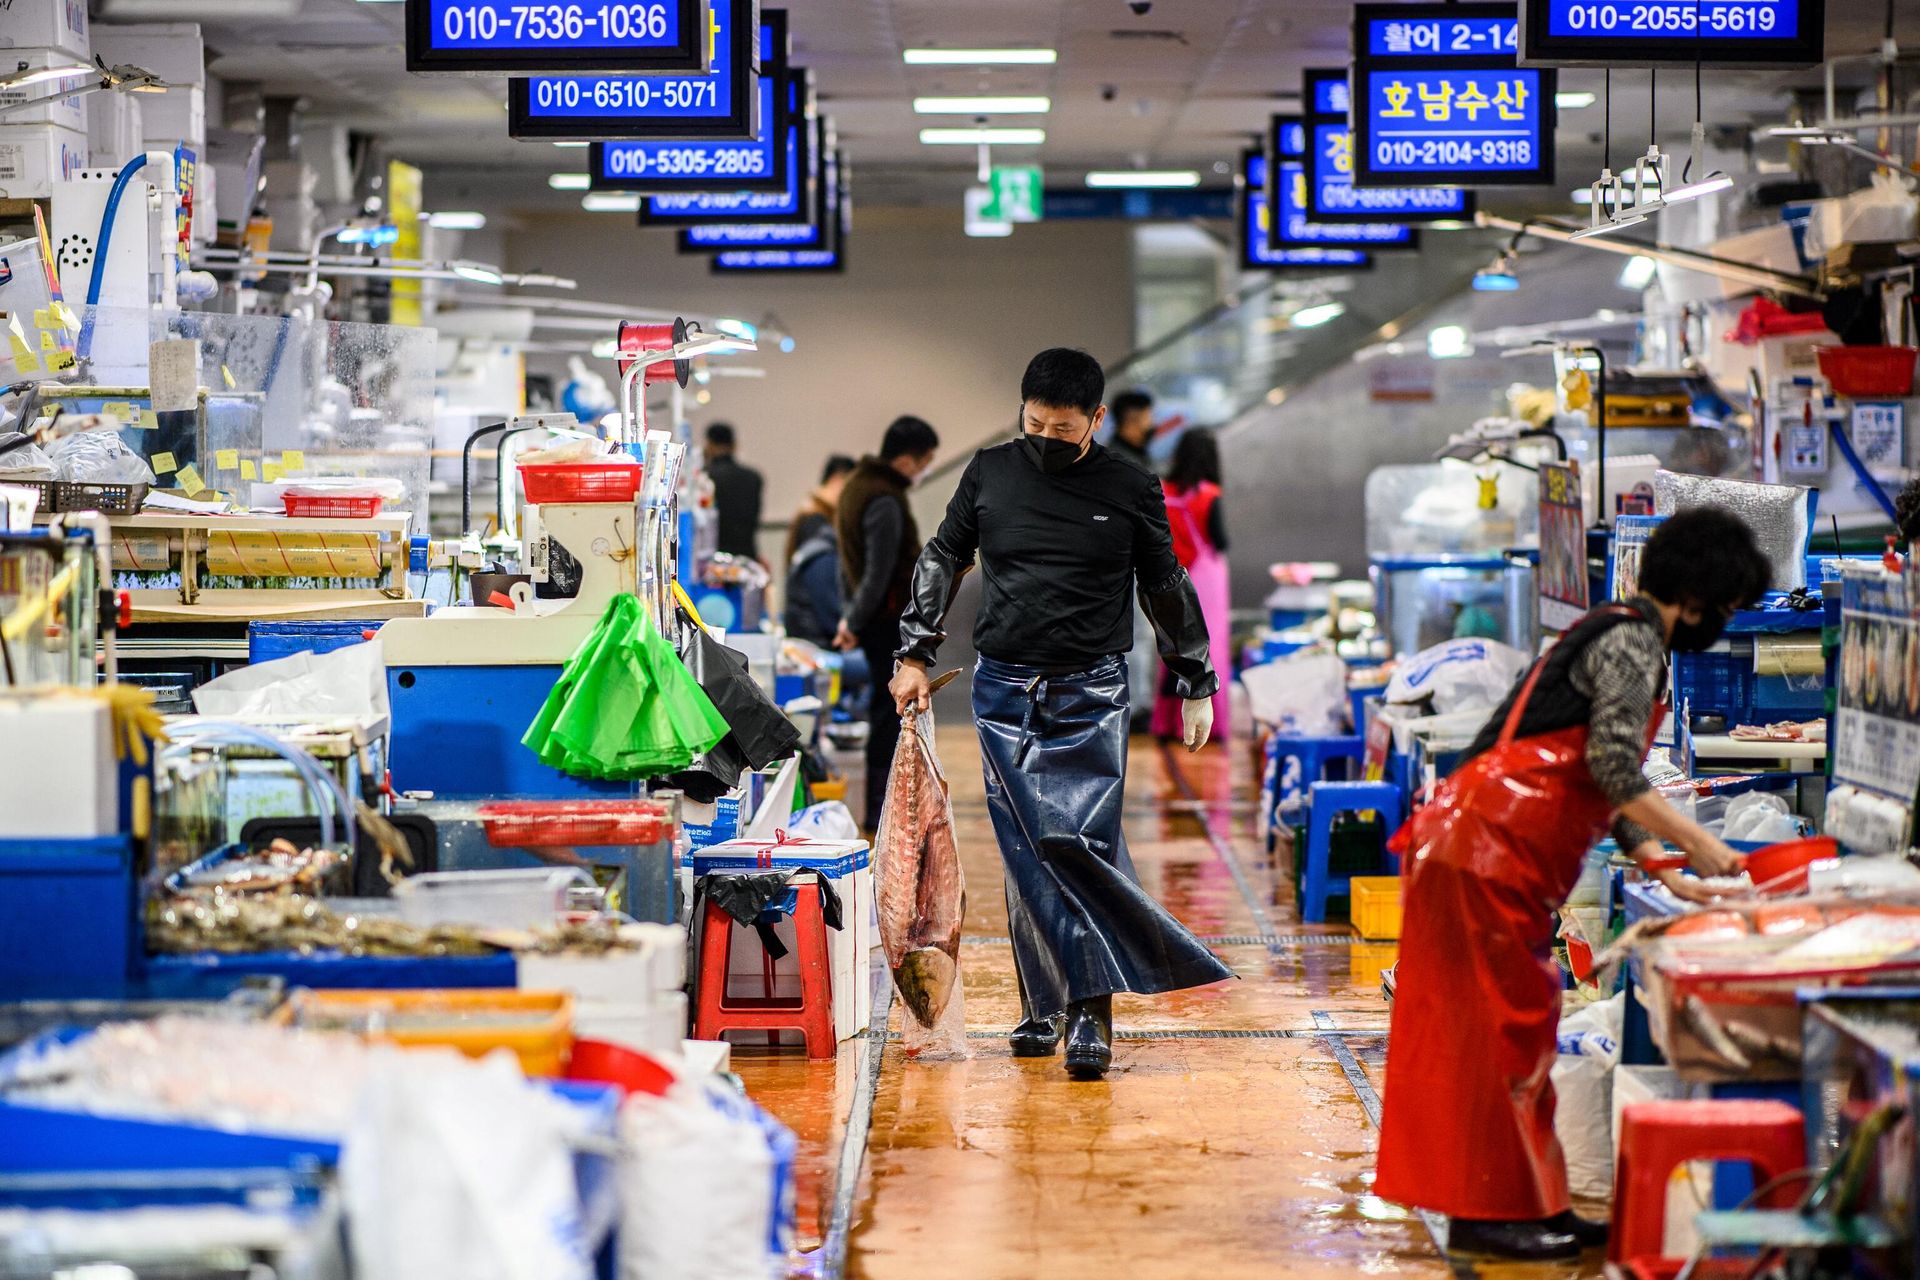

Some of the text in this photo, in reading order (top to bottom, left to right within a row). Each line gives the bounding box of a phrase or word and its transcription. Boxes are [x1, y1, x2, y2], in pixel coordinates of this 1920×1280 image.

[444, 5, 668, 40] 010-7536-1036
[1567, 5, 1776, 32] 010-2055-5619
[1383, 23, 1440, 52] 활어
[537, 80, 717, 108] 010-6510-5071
[1379, 79, 1530, 121] 호남수산
[610, 149, 765, 174] 010-5305-2805
[1377, 140, 1532, 165] 010-2104-9318
